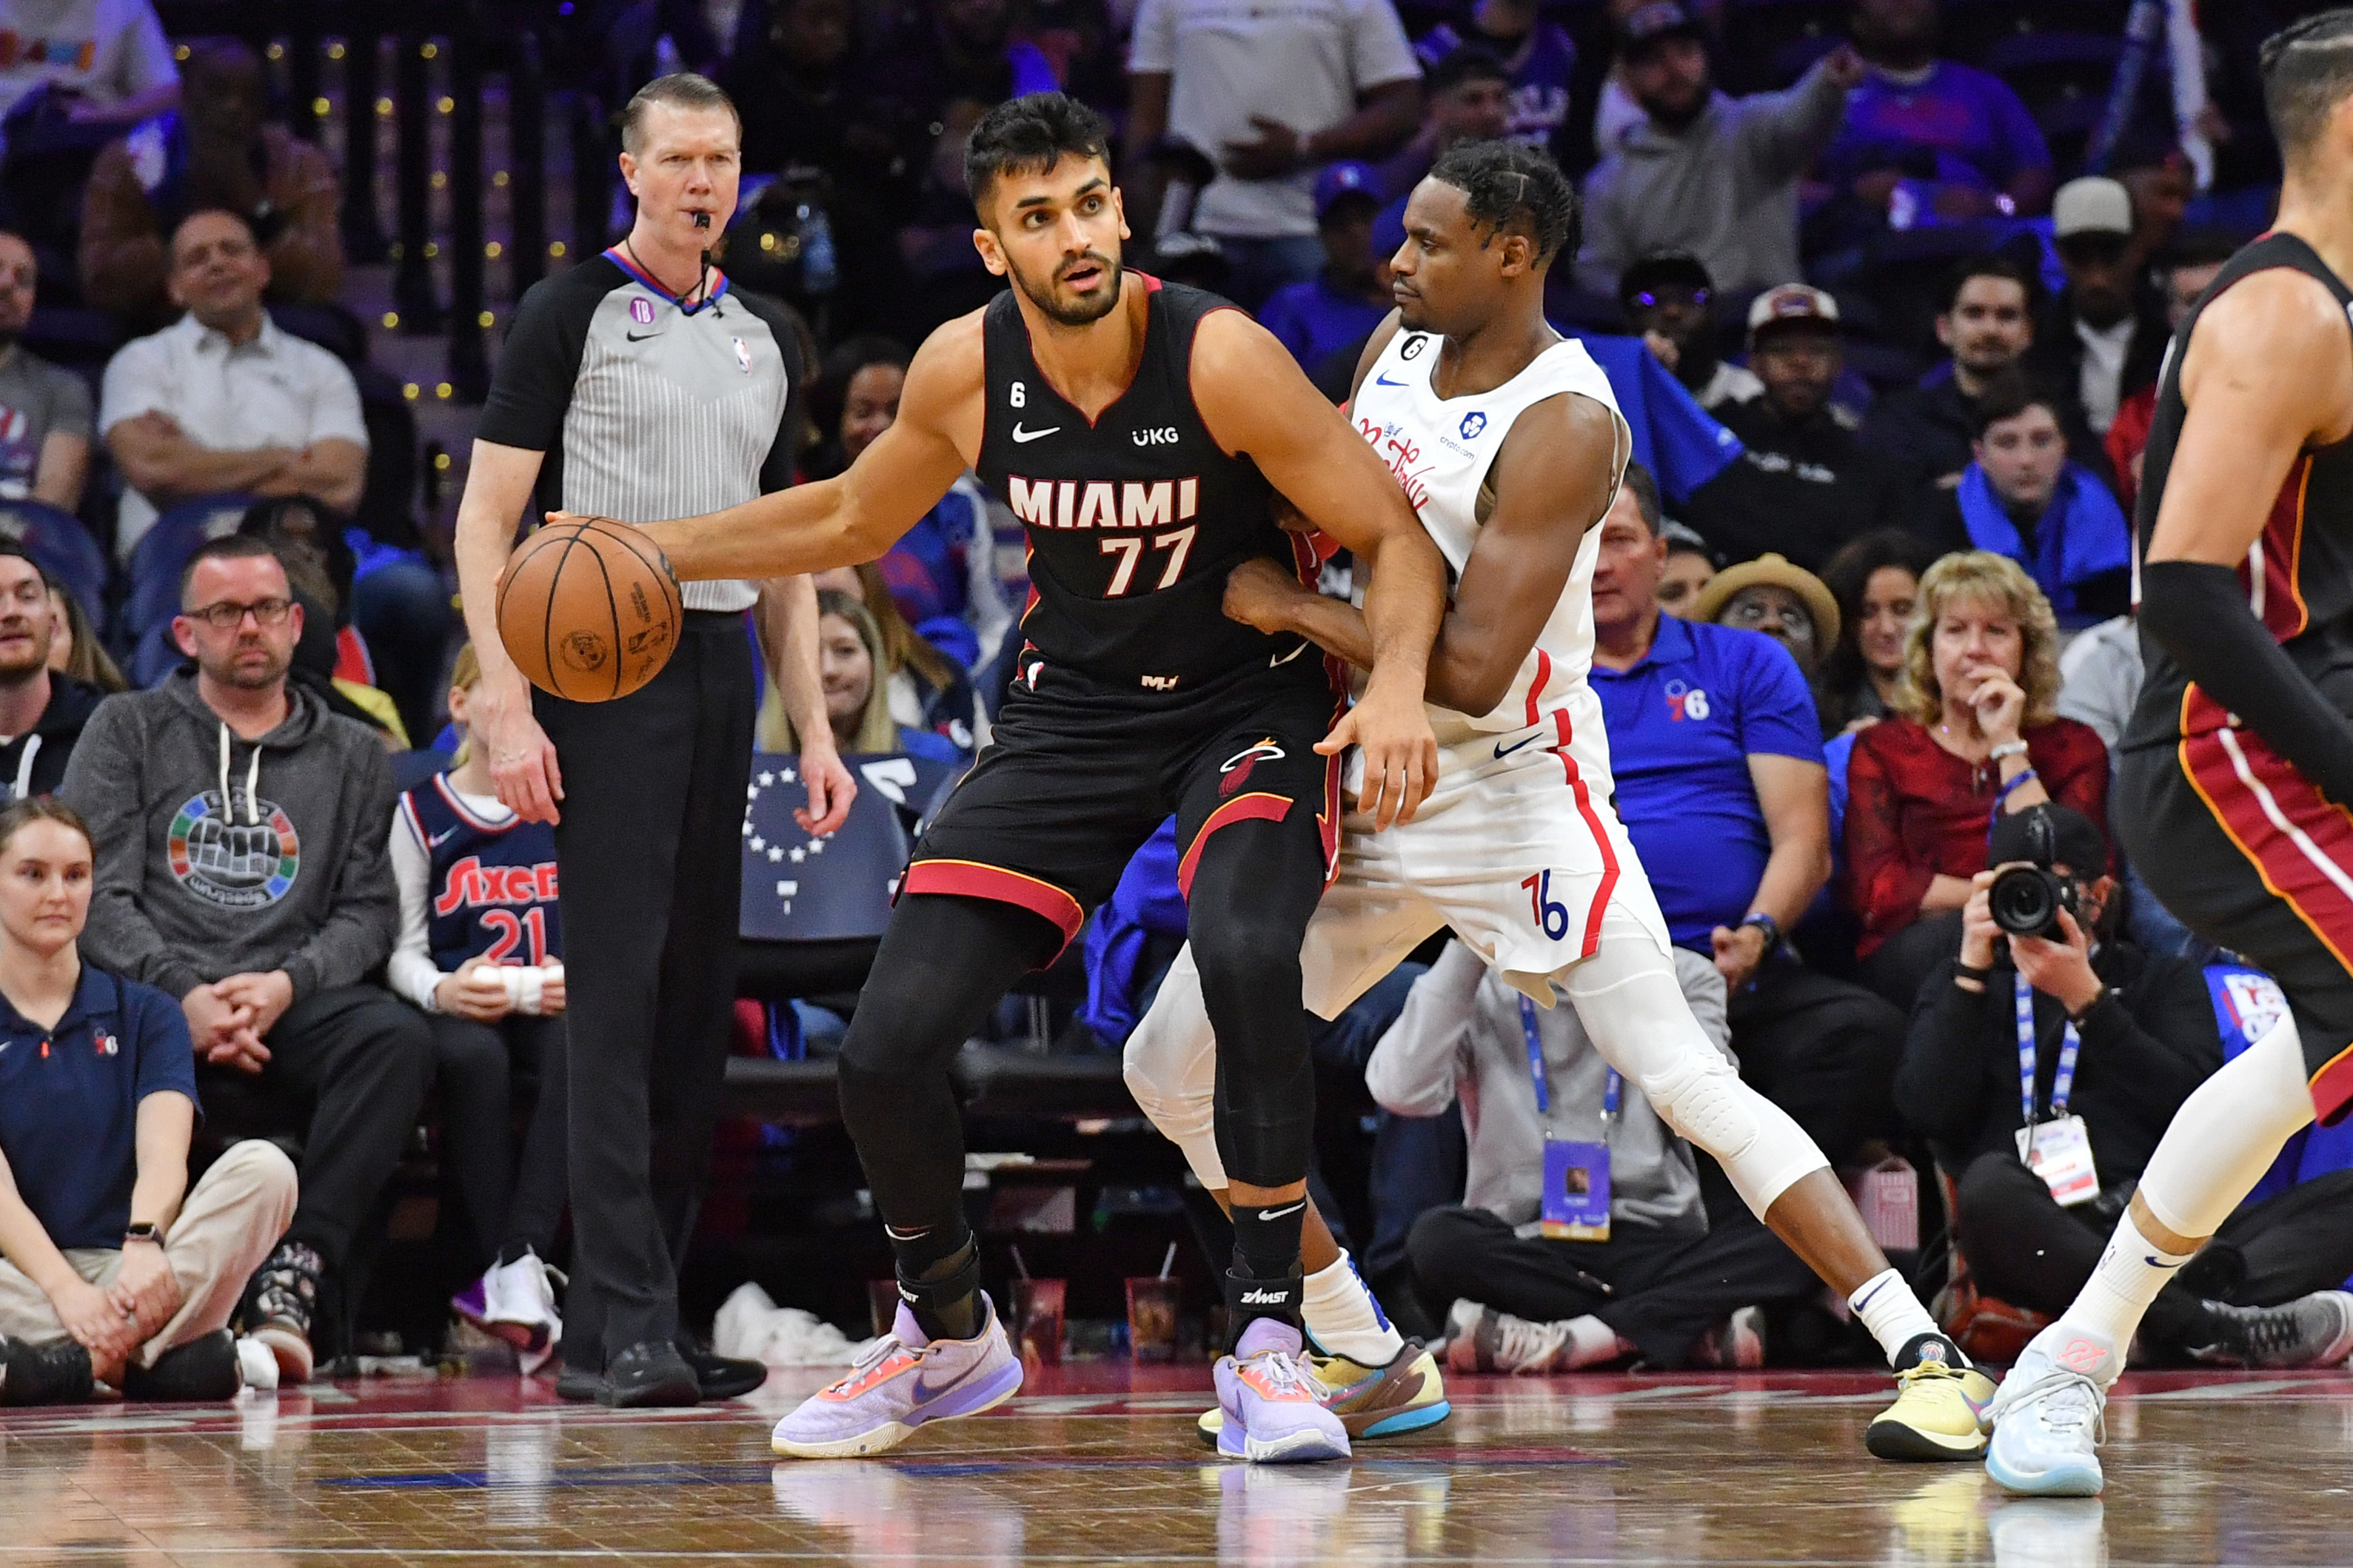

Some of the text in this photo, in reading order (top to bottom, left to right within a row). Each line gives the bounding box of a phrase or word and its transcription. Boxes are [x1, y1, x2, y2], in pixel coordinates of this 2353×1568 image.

[1401, 335, 1429, 361] 6
[1009, 381, 1026, 408] 6
[1008, 474, 1199, 529] MIAMI
[1099, 523, 1199, 598] 77
[1666, 688, 1710, 722] 76
[1521, 868, 1569, 941] 76
[479, 906, 547, 967] 21
[1240, 1287, 1289, 1304] ZAMST
